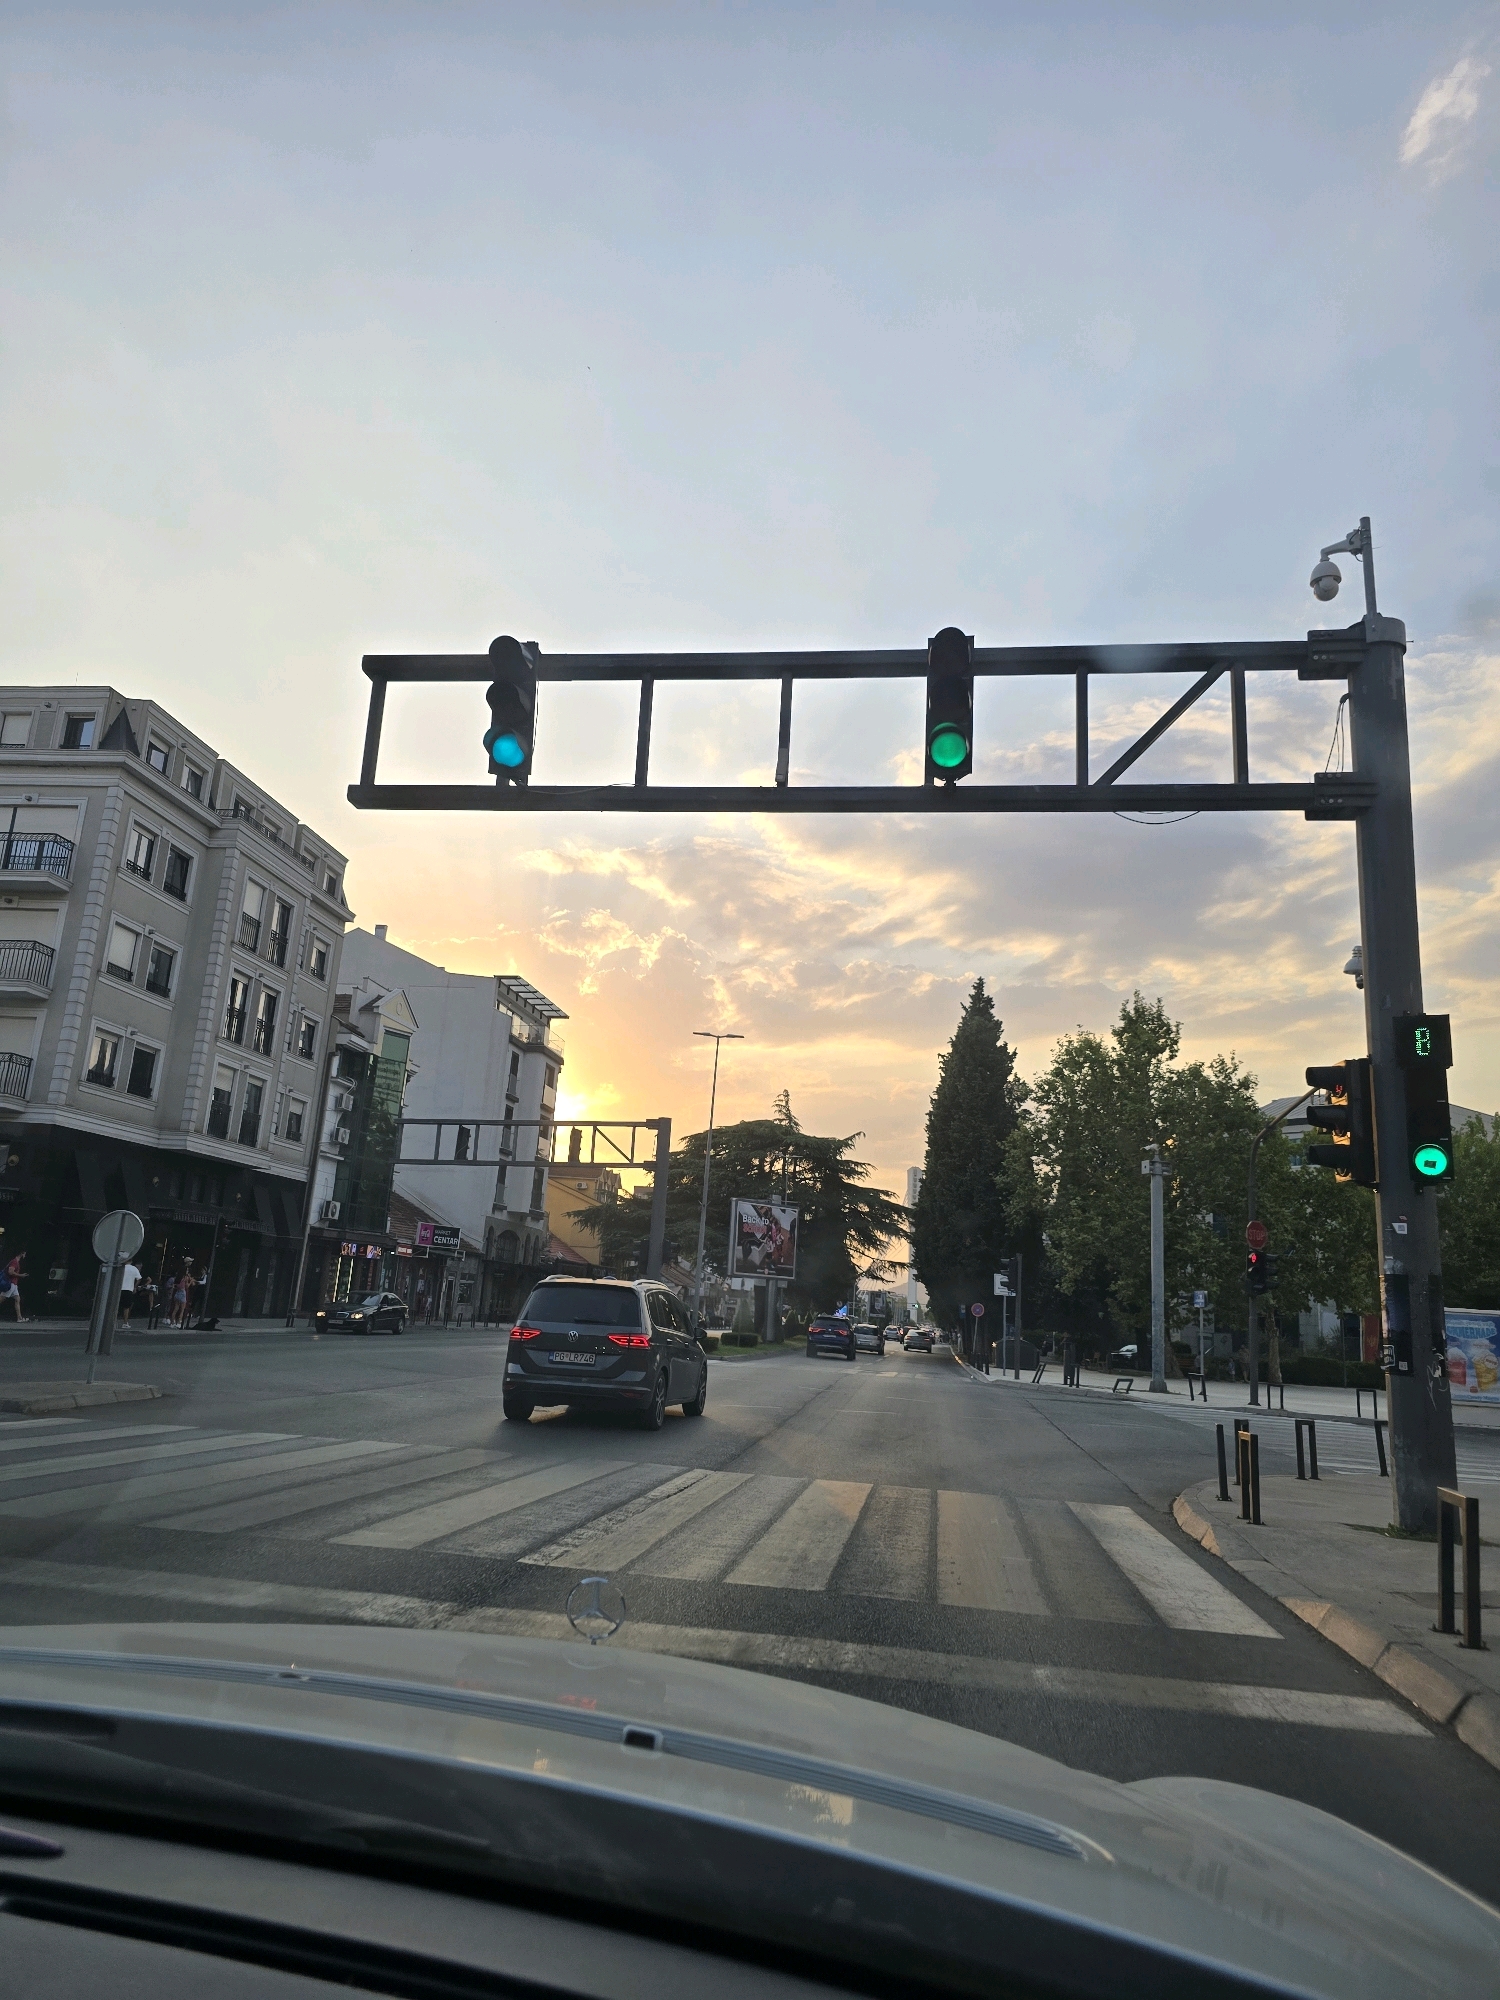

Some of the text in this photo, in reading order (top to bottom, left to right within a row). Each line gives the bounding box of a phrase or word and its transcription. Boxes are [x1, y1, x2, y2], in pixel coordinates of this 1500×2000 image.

[742, 1214, 770, 1225] Back to
[1248, 1228, 1265, 1241] STOP
[433, 1236, 459, 1245] CENTAR
[554, 1352, 595, 1363] PG LR746
